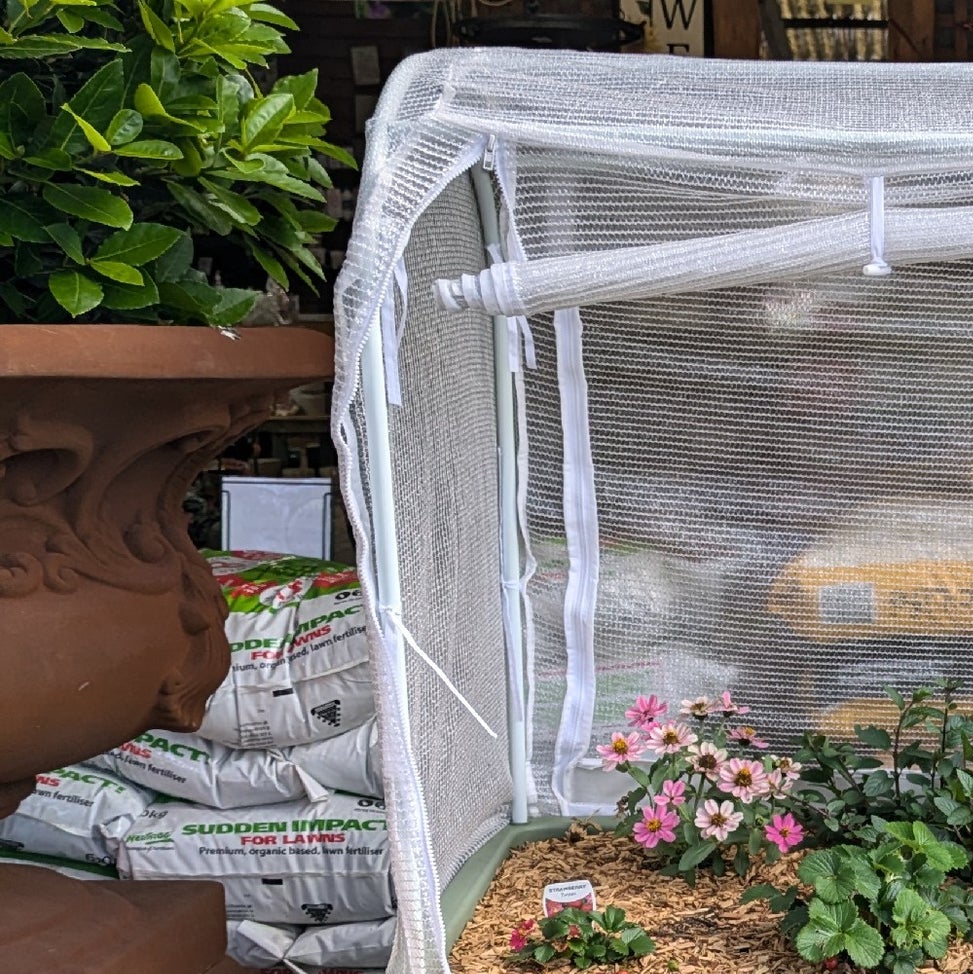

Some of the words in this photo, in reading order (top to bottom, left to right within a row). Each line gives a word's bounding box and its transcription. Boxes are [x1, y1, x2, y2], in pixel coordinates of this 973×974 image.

[295, 604, 363, 635] MPAC
[229, 634, 291, 652] DDE
[260, 658, 286, 670] organ
[289, 649, 309, 661] sed,
[333, 626, 367, 642] fertilise
[182, 822, 288, 835] SUDDEN
[291, 819, 387, 832] IMPACT
[241, 835, 277, 845] FOR
[283, 833, 345, 844] LAWNS
[199, 846, 247, 855] Premium,
[249, 848, 286, 857] organic
[346, 846, 384, 855] fertiliser
